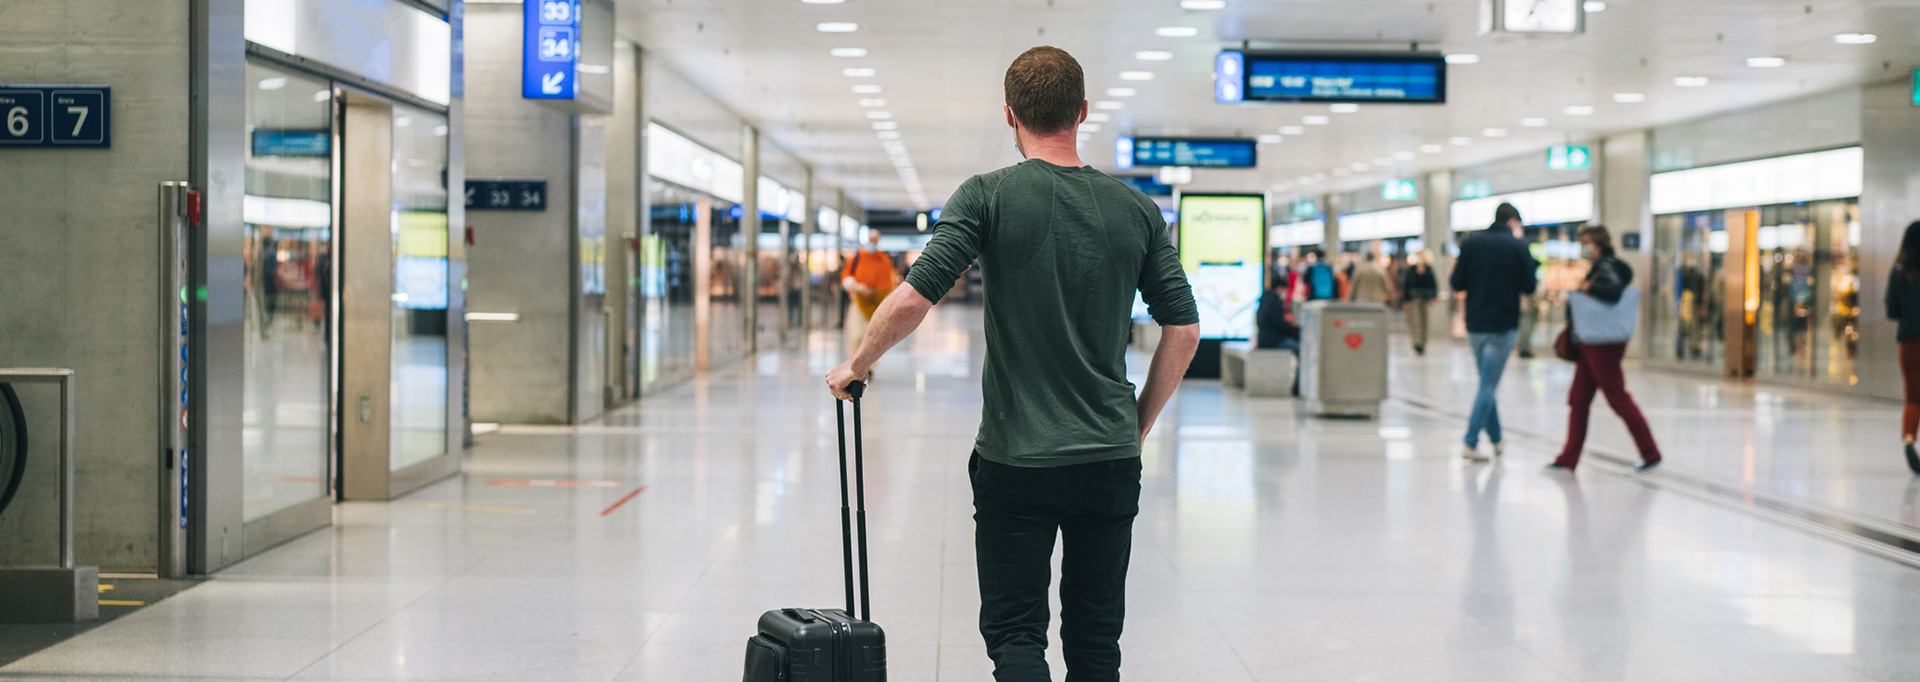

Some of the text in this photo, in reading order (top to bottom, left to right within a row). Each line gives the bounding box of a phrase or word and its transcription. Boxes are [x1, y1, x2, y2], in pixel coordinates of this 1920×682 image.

[544, 1, 570, 21] 33
[542, 38, 569, 58] 34
[7, 106, 29, 137] 6
[67, 106, 88, 137] 7
